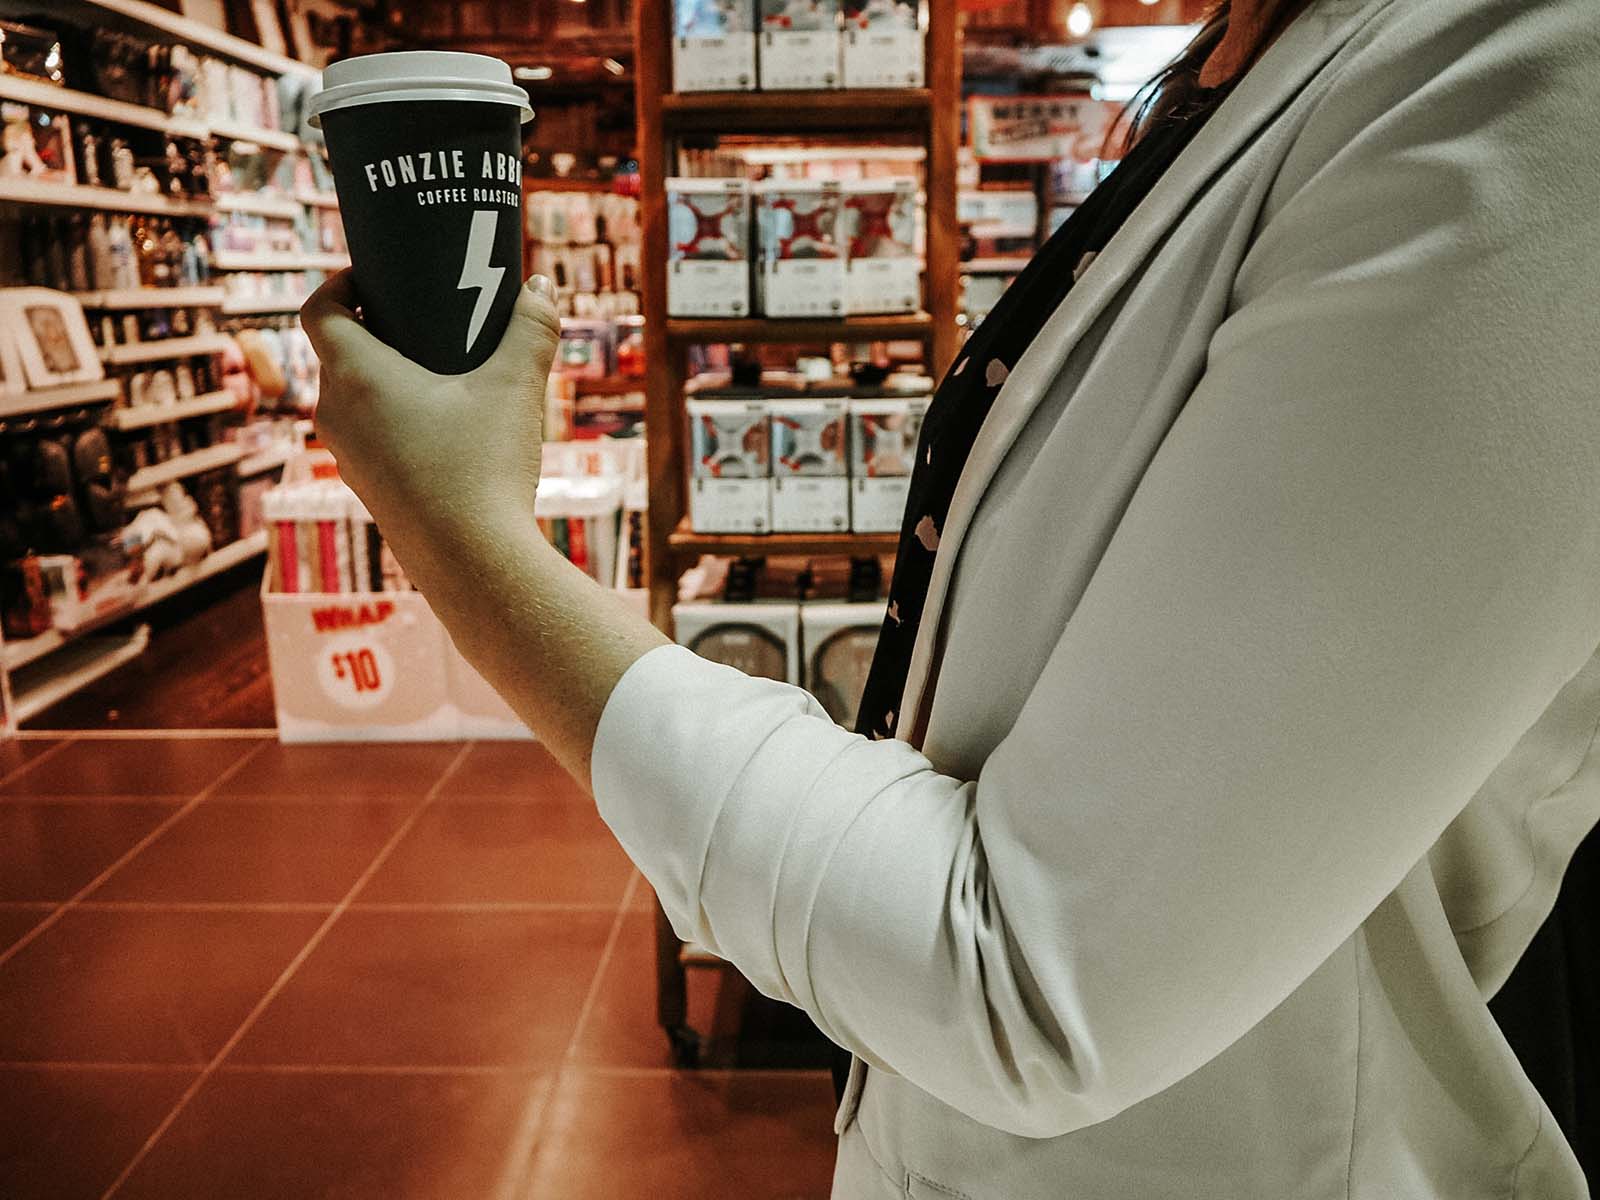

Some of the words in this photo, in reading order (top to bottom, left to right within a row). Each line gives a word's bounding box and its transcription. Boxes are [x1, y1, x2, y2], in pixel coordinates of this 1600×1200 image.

[365, 150, 465, 192] FONZIE
[417, 188, 467, 205] COFFEE
[331, 648, 381, 692] $10
